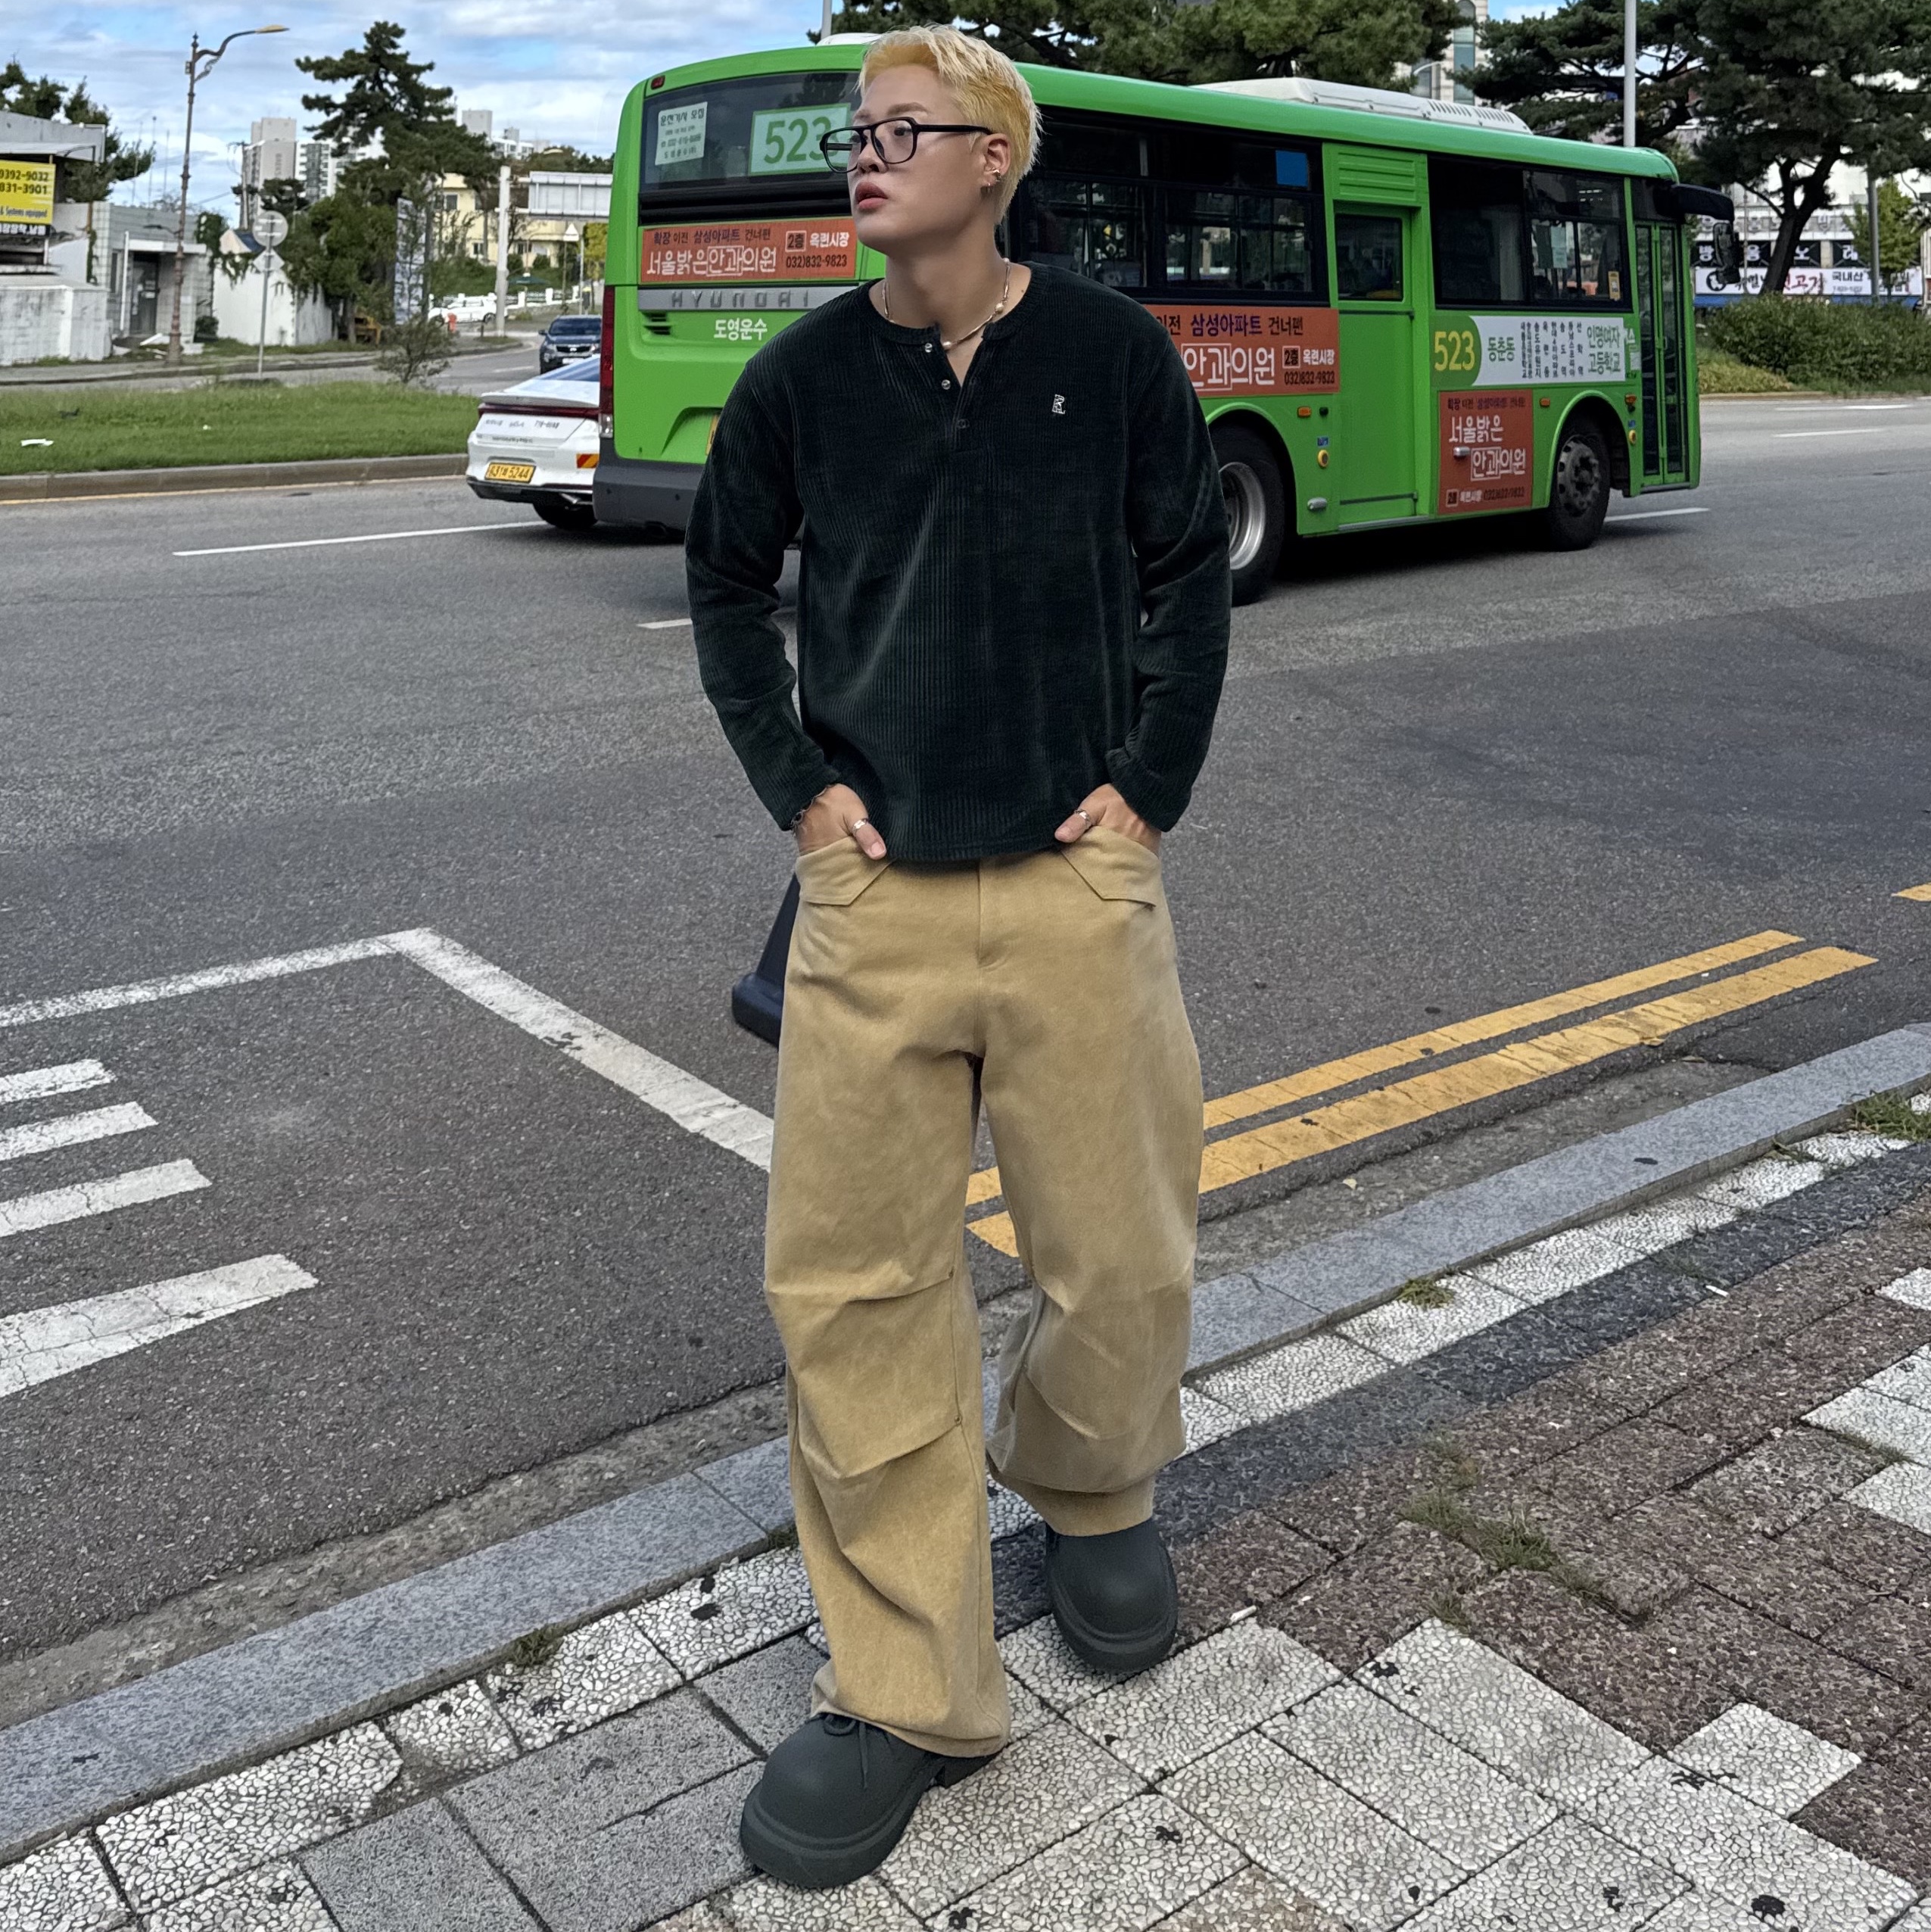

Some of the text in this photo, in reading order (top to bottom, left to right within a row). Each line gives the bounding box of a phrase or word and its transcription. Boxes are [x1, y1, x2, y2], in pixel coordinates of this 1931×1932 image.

[661, 111, 687, 126] 운전기사
[764, 116, 839, 164] 523
[653, 231, 671, 245] 확장
[673, 231, 689, 244] 이전
[693, 228, 740, 243] 삼성아파트
[787, 235, 805, 248] 2층
[809, 232, 849, 248] 옥련시장
[646, 246, 848, 276] 서울밝은안과의원 032)832-9823
[1832, 271, 1864, 282] 국내산
[671, 290, 808, 308] HYUNDAI
[714, 318, 768, 341] 도영운수
[1190, 313, 1263, 337] 삼성아파트
[1587, 326, 1621, 348] 인명여자
[1284, 347, 1298, 366] 2층
[1303, 349, 1335, 366] 옥련시장
[1434, 329, 1475, 372] 523
[1487, 336, 1515, 362] 동춘동
[1588, 352, 1621, 375] 고등학교
[1449, 415, 1504, 444] 서울밝은
[509, 466, 530, 478] 5244
[1472, 448, 1526, 478] 안과의원
